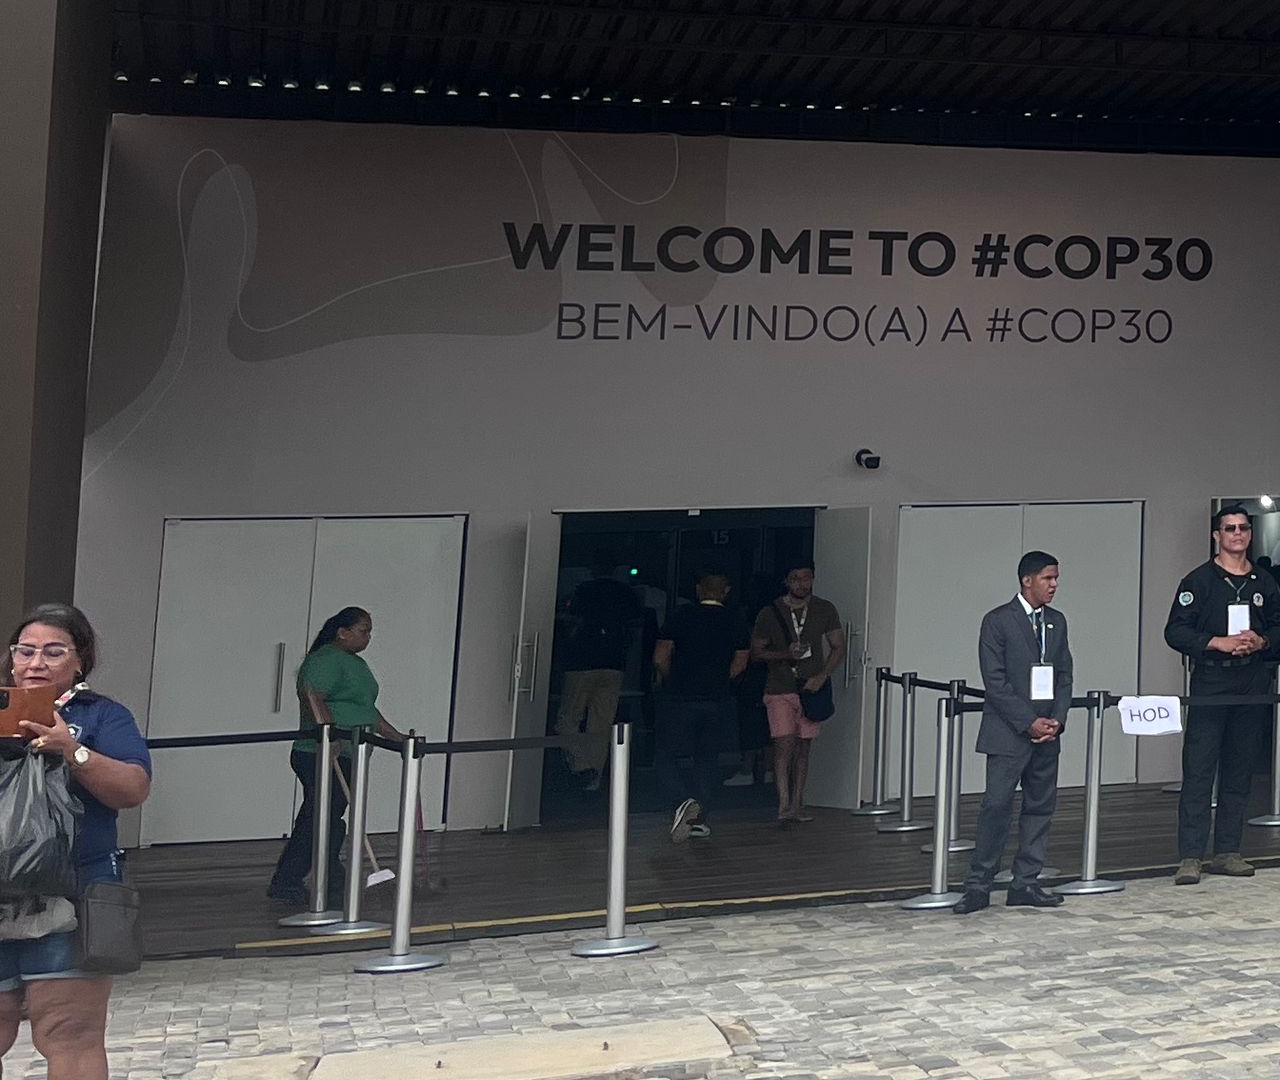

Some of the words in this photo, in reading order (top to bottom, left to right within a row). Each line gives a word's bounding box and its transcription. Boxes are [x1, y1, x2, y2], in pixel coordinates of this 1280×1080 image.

[503, 222, 853, 277] WELCOME
[868, 231, 956, 278] TO
[971, 233, 1213, 282] #COP30
[556, 303, 928, 347] BEM-VINDO(A)
[939, 307, 972, 343] A
[986, 308, 1174, 344] #COP30
[1129, 706, 1170, 722] HOD
